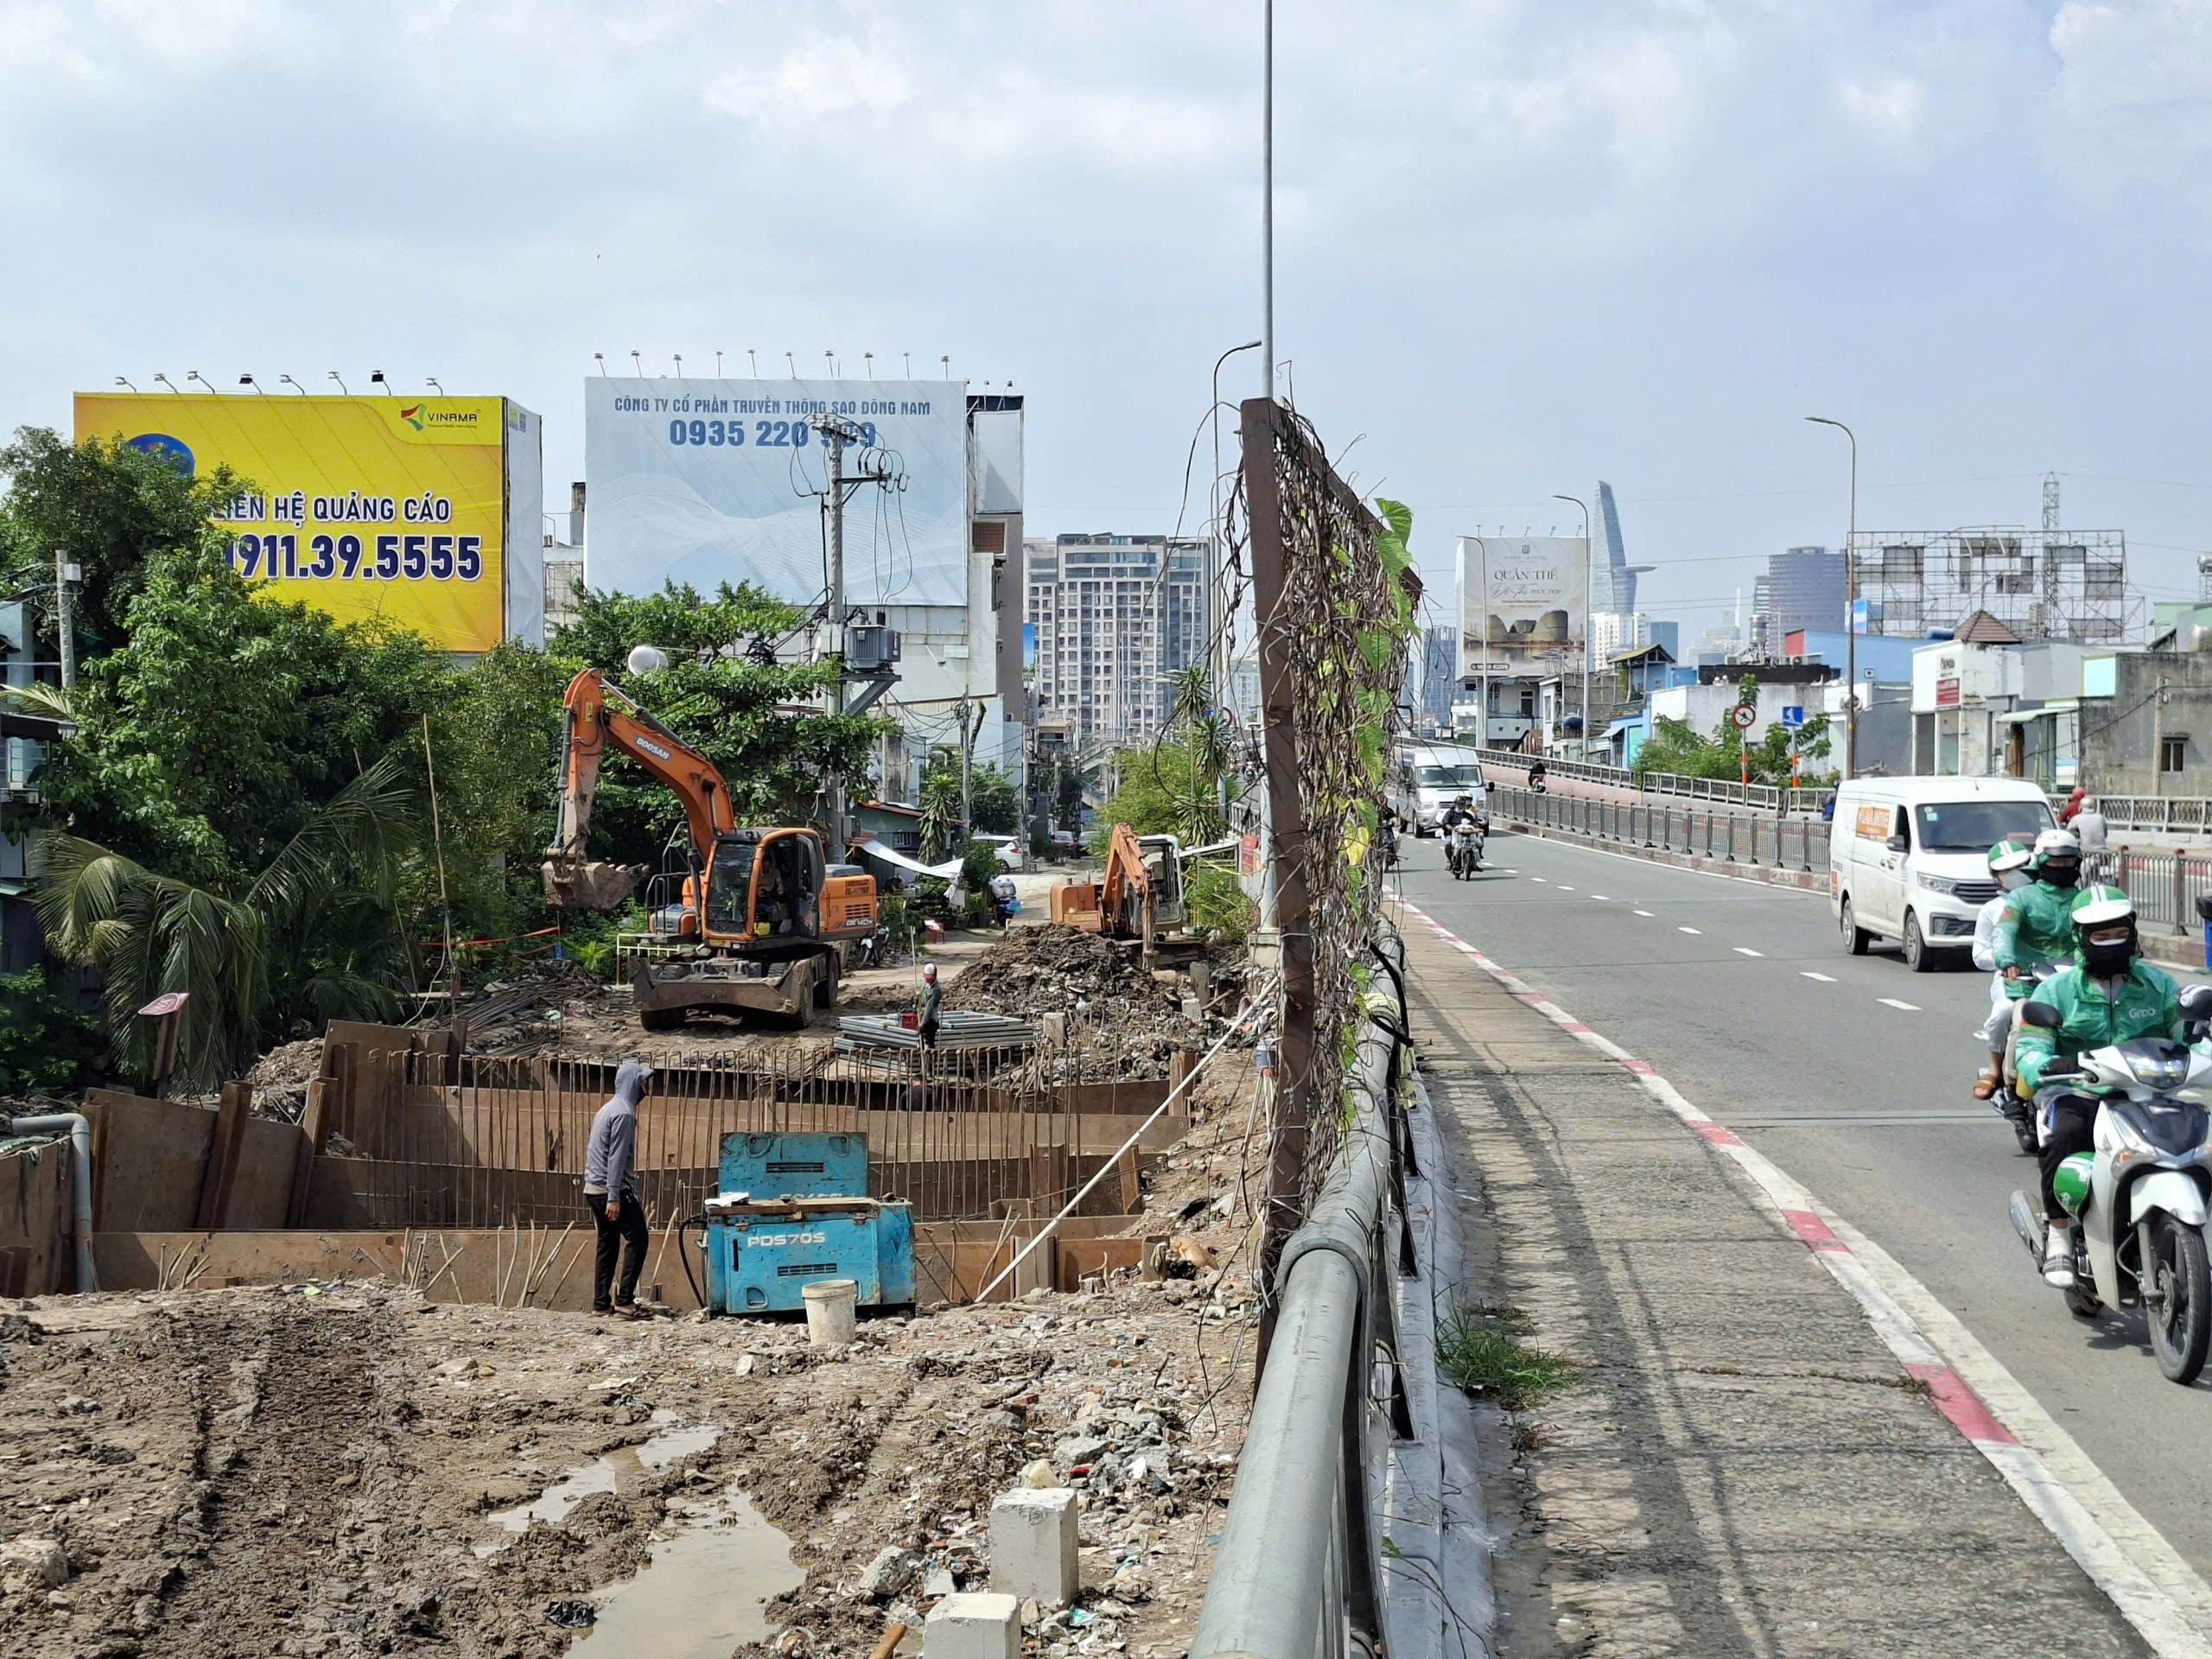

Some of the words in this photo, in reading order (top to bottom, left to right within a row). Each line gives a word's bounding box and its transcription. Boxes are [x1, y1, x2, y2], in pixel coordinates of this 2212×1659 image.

[614, 395, 650, 412] CÔNG
[654, 398, 669, 412] TY
[785, 398, 826, 414] THÔNG
[831, 401, 856, 415] SAO
[900, 401, 931, 416] NAM
[427, 413, 477, 423] VINAMA
[670, 419, 745, 447] 0935
[755, 420, 809, 448] 220
[274, 492, 305, 527] HỆ
[313, 491, 394, 520] QUẢNG
[404, 492, 450, 520] CÁO
[635, 736, 670, 760] DOOSAN
[747, 1231, 827, 1247] PDS70S
